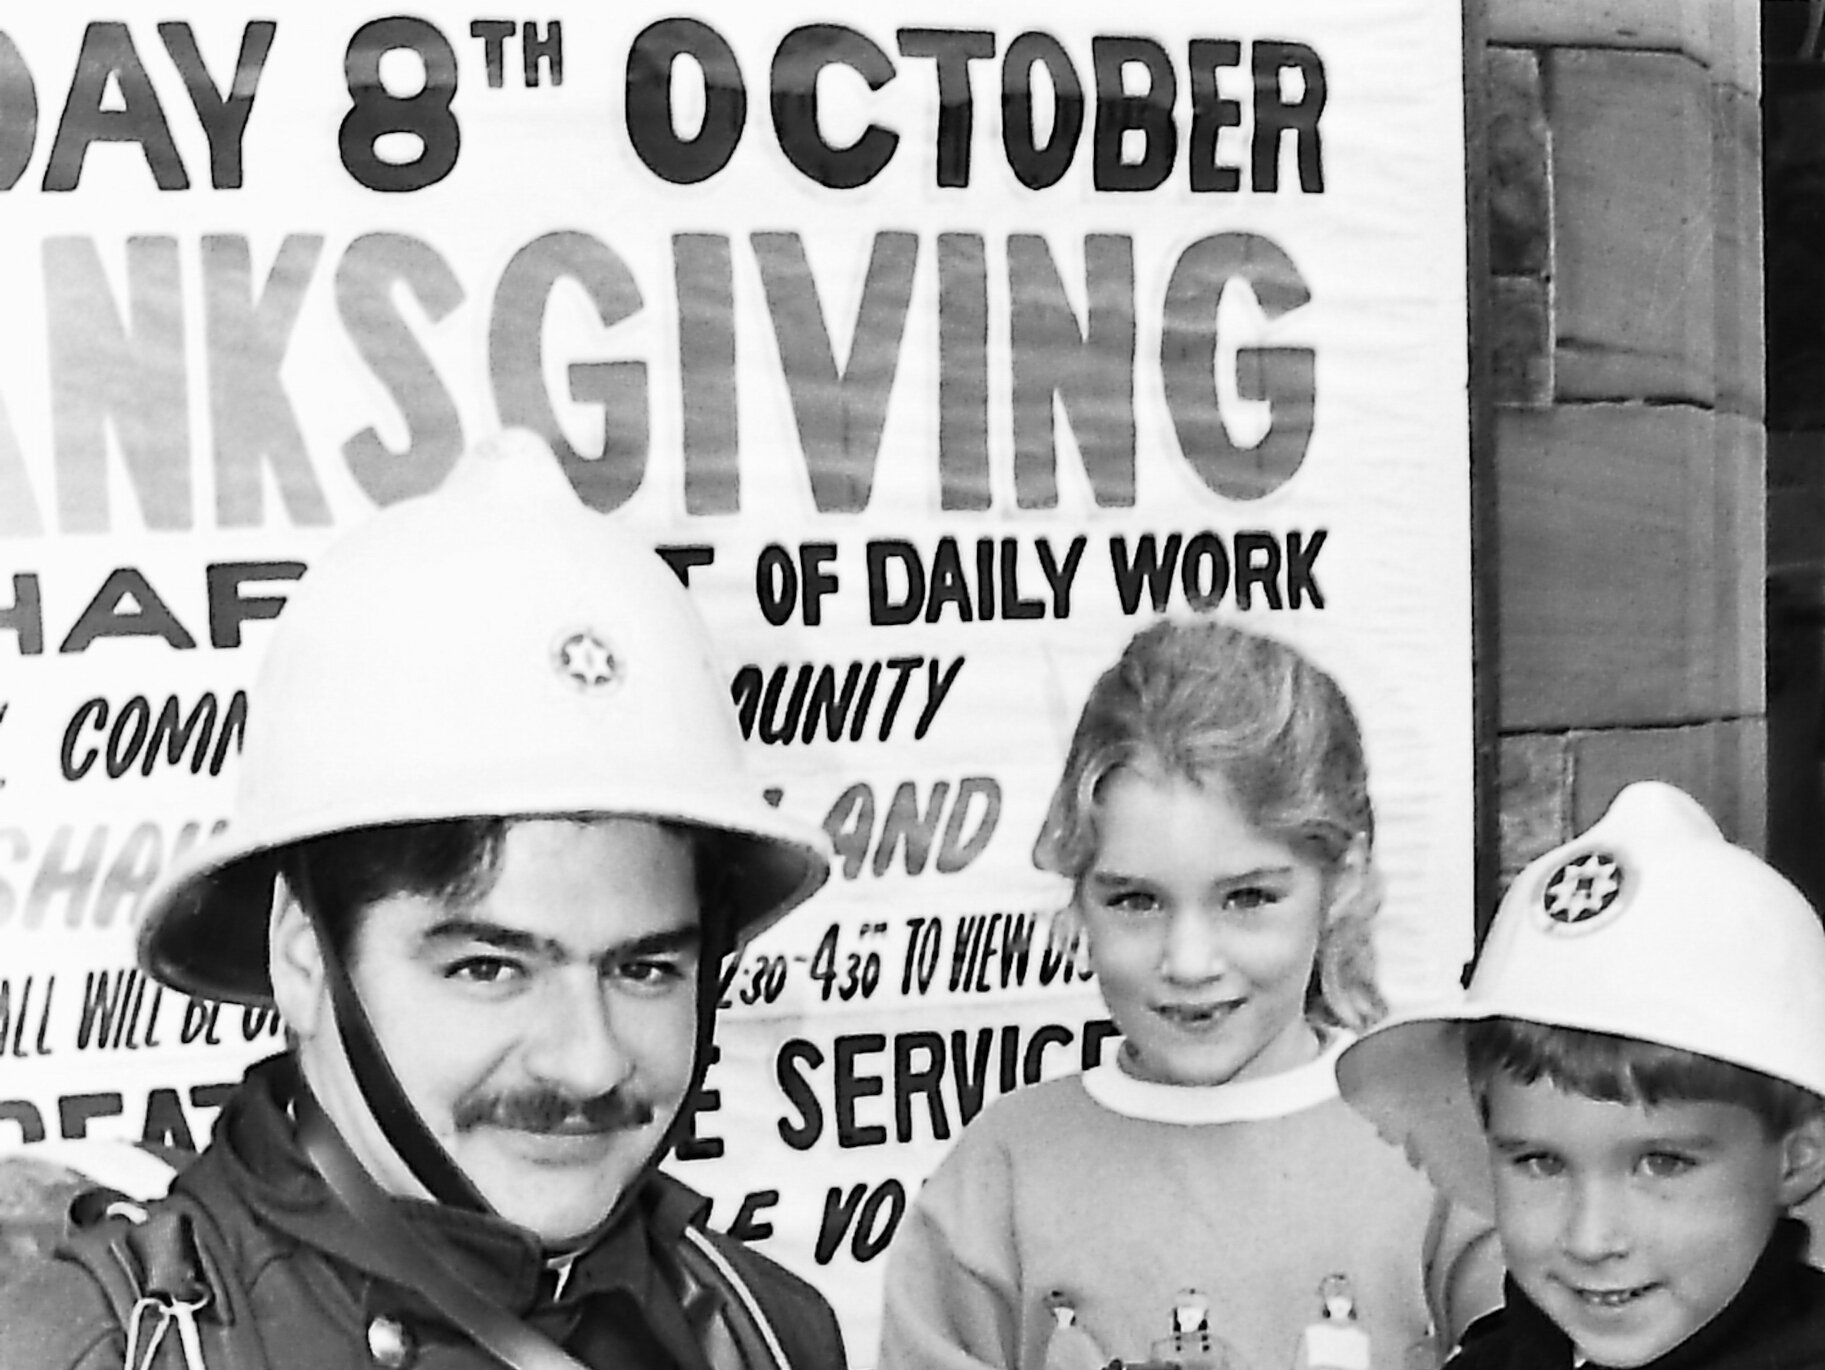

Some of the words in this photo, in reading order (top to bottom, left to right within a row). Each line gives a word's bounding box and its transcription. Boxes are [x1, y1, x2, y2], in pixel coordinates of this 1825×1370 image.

[0, 21, 277, 192] AY
[624, 17, 1327, 193] OCTOBER
[0, 230, 1316, 537] NKSGIVING
[755, 543, 839, 626] OF
[866, 535, 1087, 625] DAILY
[1109, 530, 1328, 615] WORK
[77, 968, 161, 1050] WILL
[901, 917, 942, 995] TO
[949, 912, 1037, 993] VIEW
